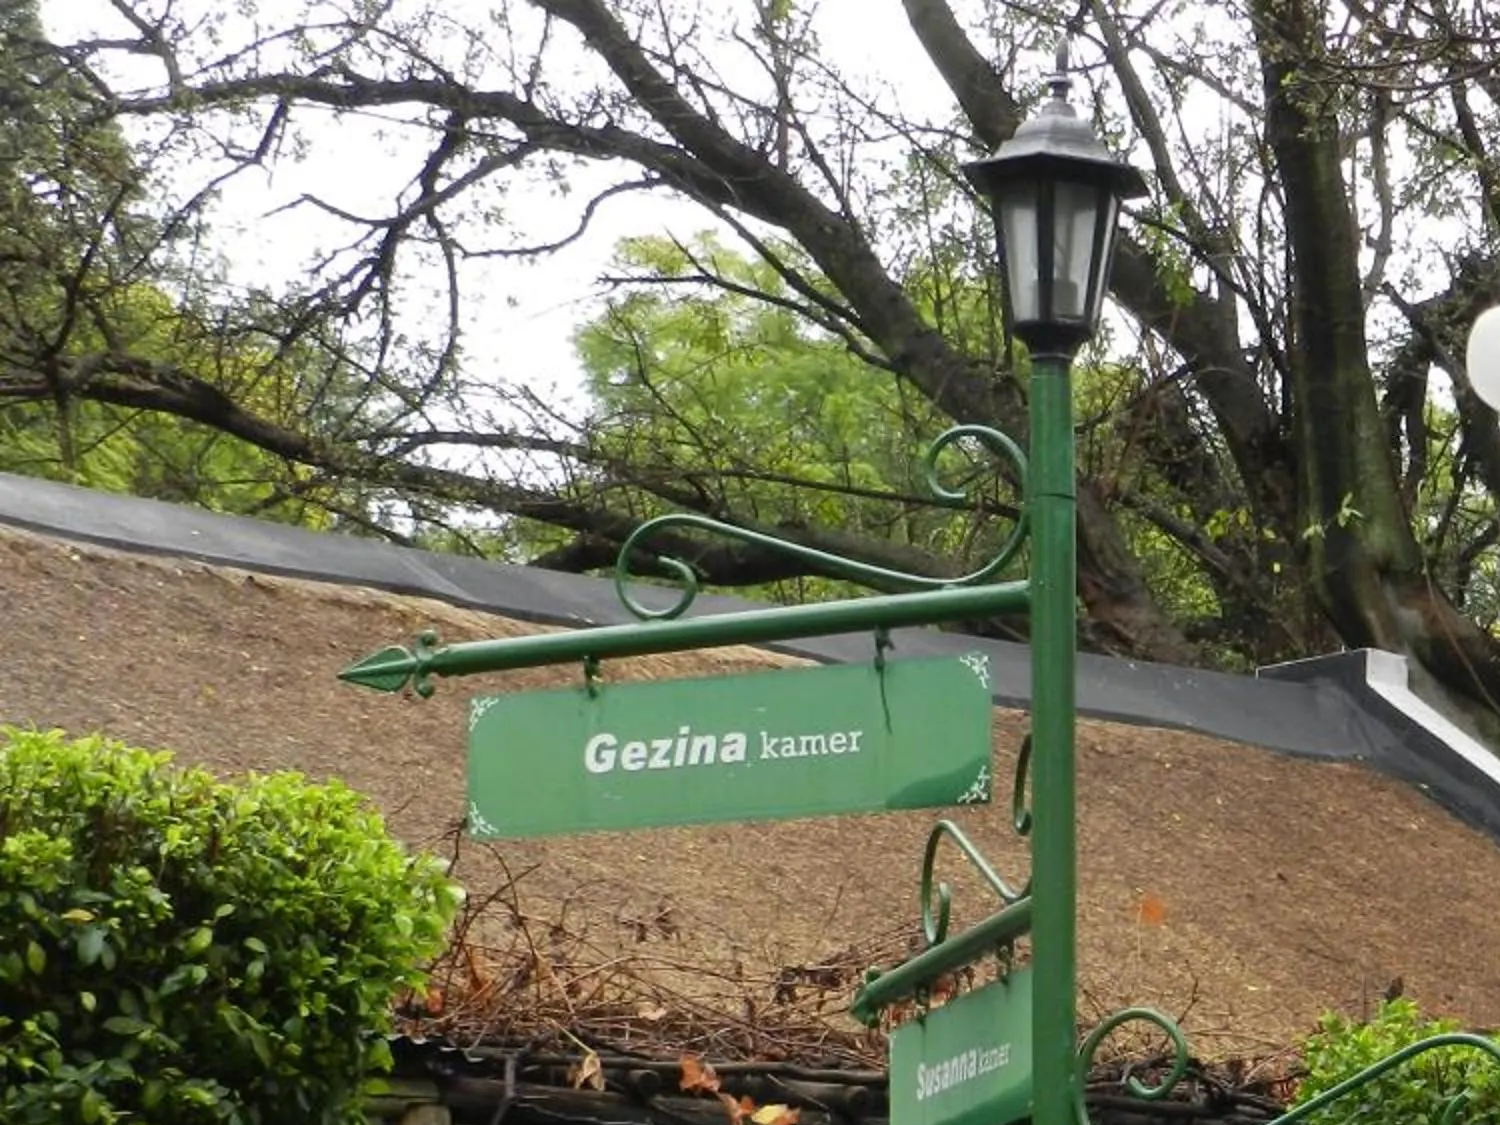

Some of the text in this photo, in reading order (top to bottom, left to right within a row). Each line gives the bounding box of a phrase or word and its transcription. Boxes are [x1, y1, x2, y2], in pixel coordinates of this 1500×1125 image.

[585, 726, 863, 773] Gezina kamer
[917, 1048, 977, 1100] Susanna
